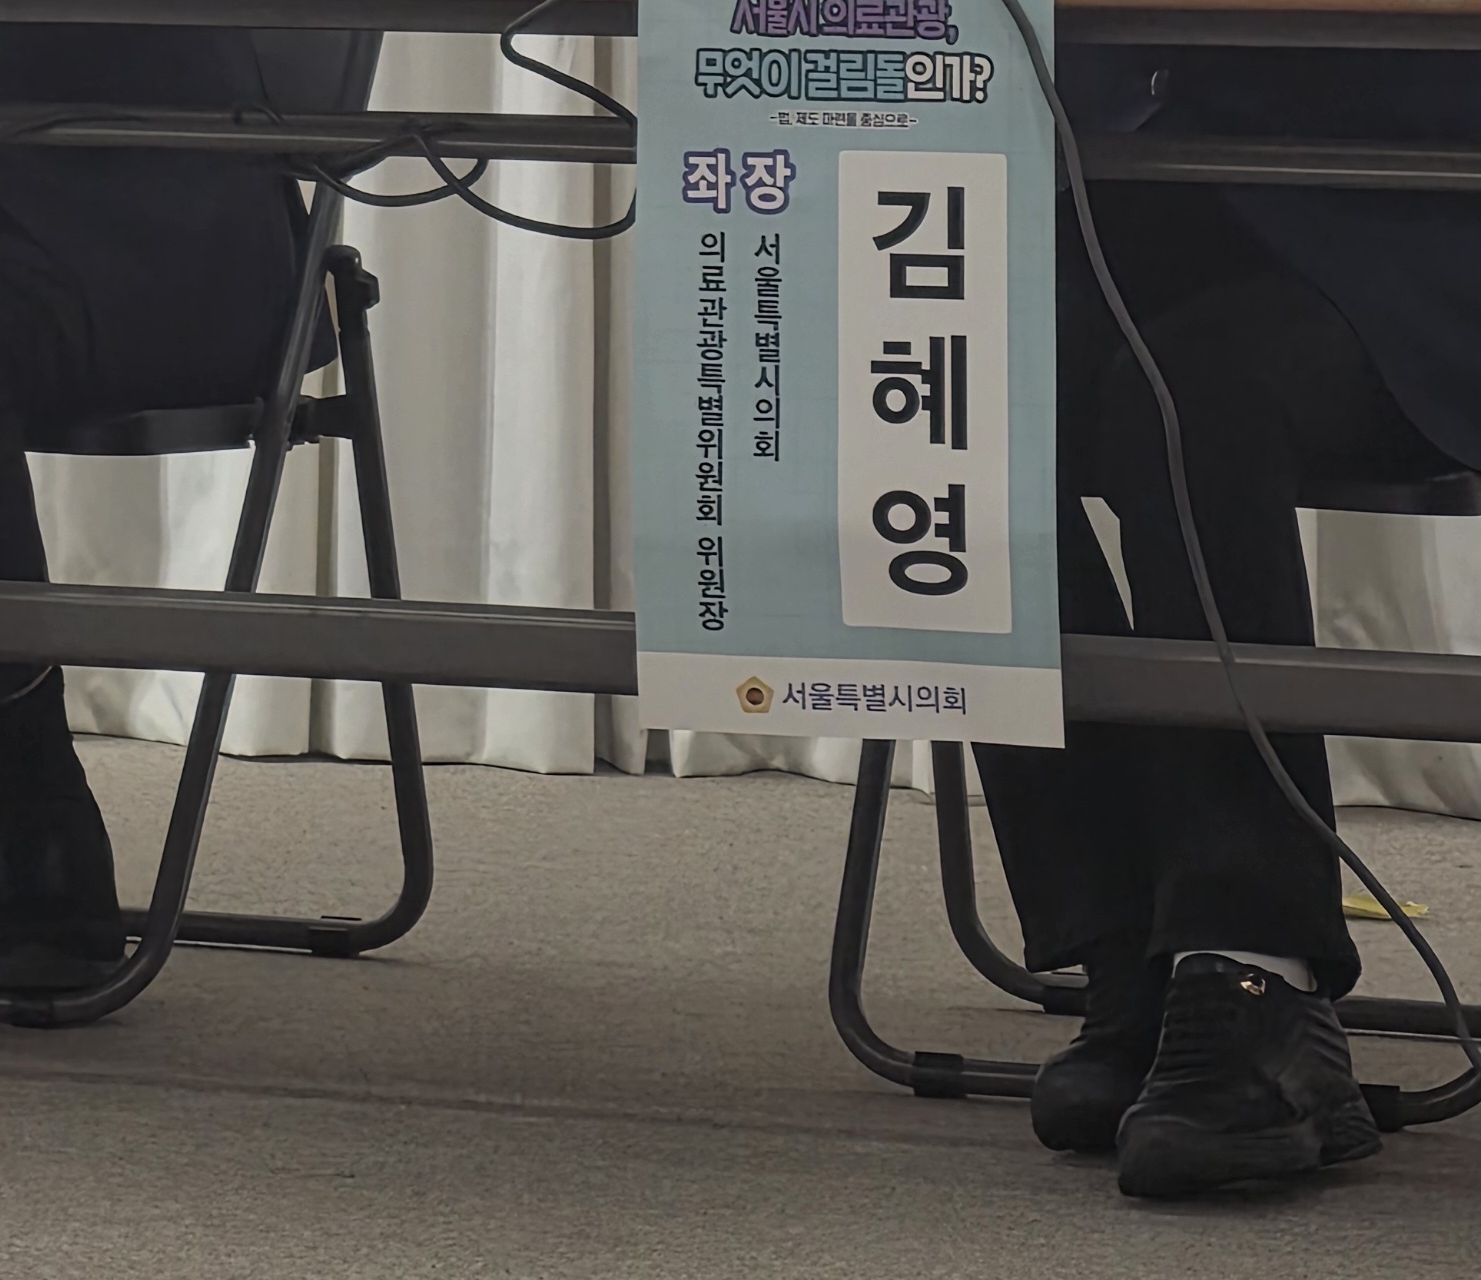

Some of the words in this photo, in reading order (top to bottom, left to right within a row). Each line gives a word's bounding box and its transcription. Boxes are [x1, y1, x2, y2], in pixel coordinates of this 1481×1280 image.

[695, 48, 802, 100] 무엇이
[804, 49, 995, 103] 걸림돌인가?
[682, 148, 796, 214] 좌장
[695, 231, 727, 526] 의료관광특별위원회
[753, 233, 782, 462] 서울특별시의회
[870, 186, 968, 596] 김혜영
[697, 535, 729, 631] 위원장
[782, 682, 967, 715] 서울특별시의회
